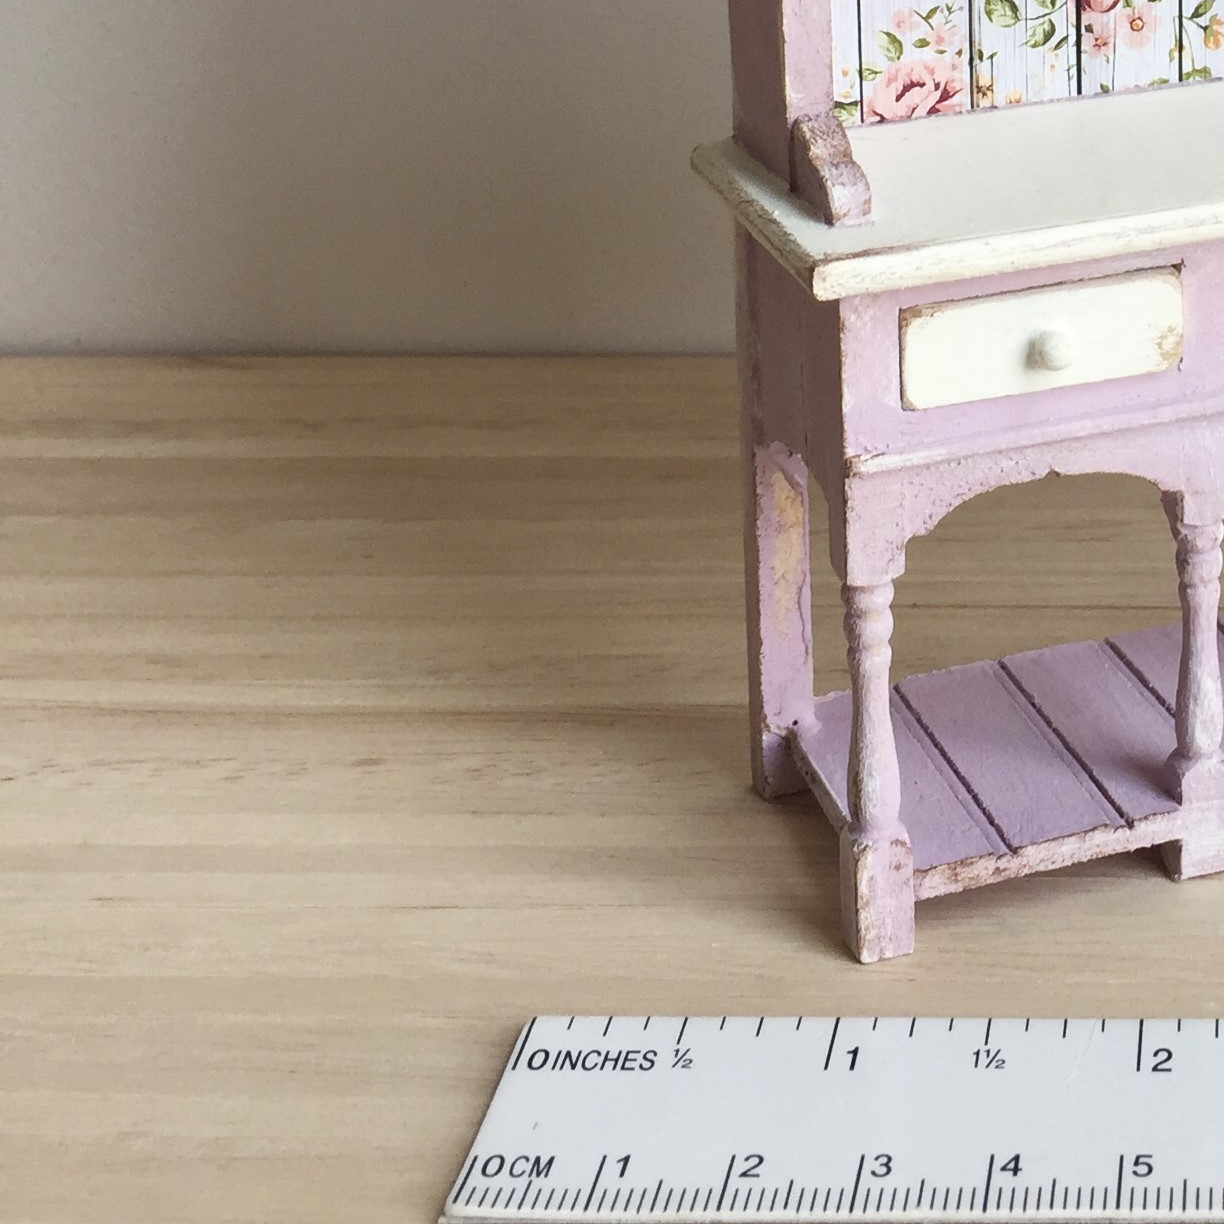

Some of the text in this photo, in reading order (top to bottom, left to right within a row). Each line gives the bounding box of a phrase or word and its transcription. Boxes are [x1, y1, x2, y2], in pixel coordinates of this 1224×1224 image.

[846, 1046, 860, 1072] 1
[1151, 1047, 1173, 1073] 2
[508, 1155, 556, 1179] CM
[616, 1154, 632, 1179] 1
[738, 1154, 765, 1178] 2
[870, 1153, 893, 1178] 3
[999, 1153, 1023, 1177] 4
[1131, 1154, 1154, 1178] 5
